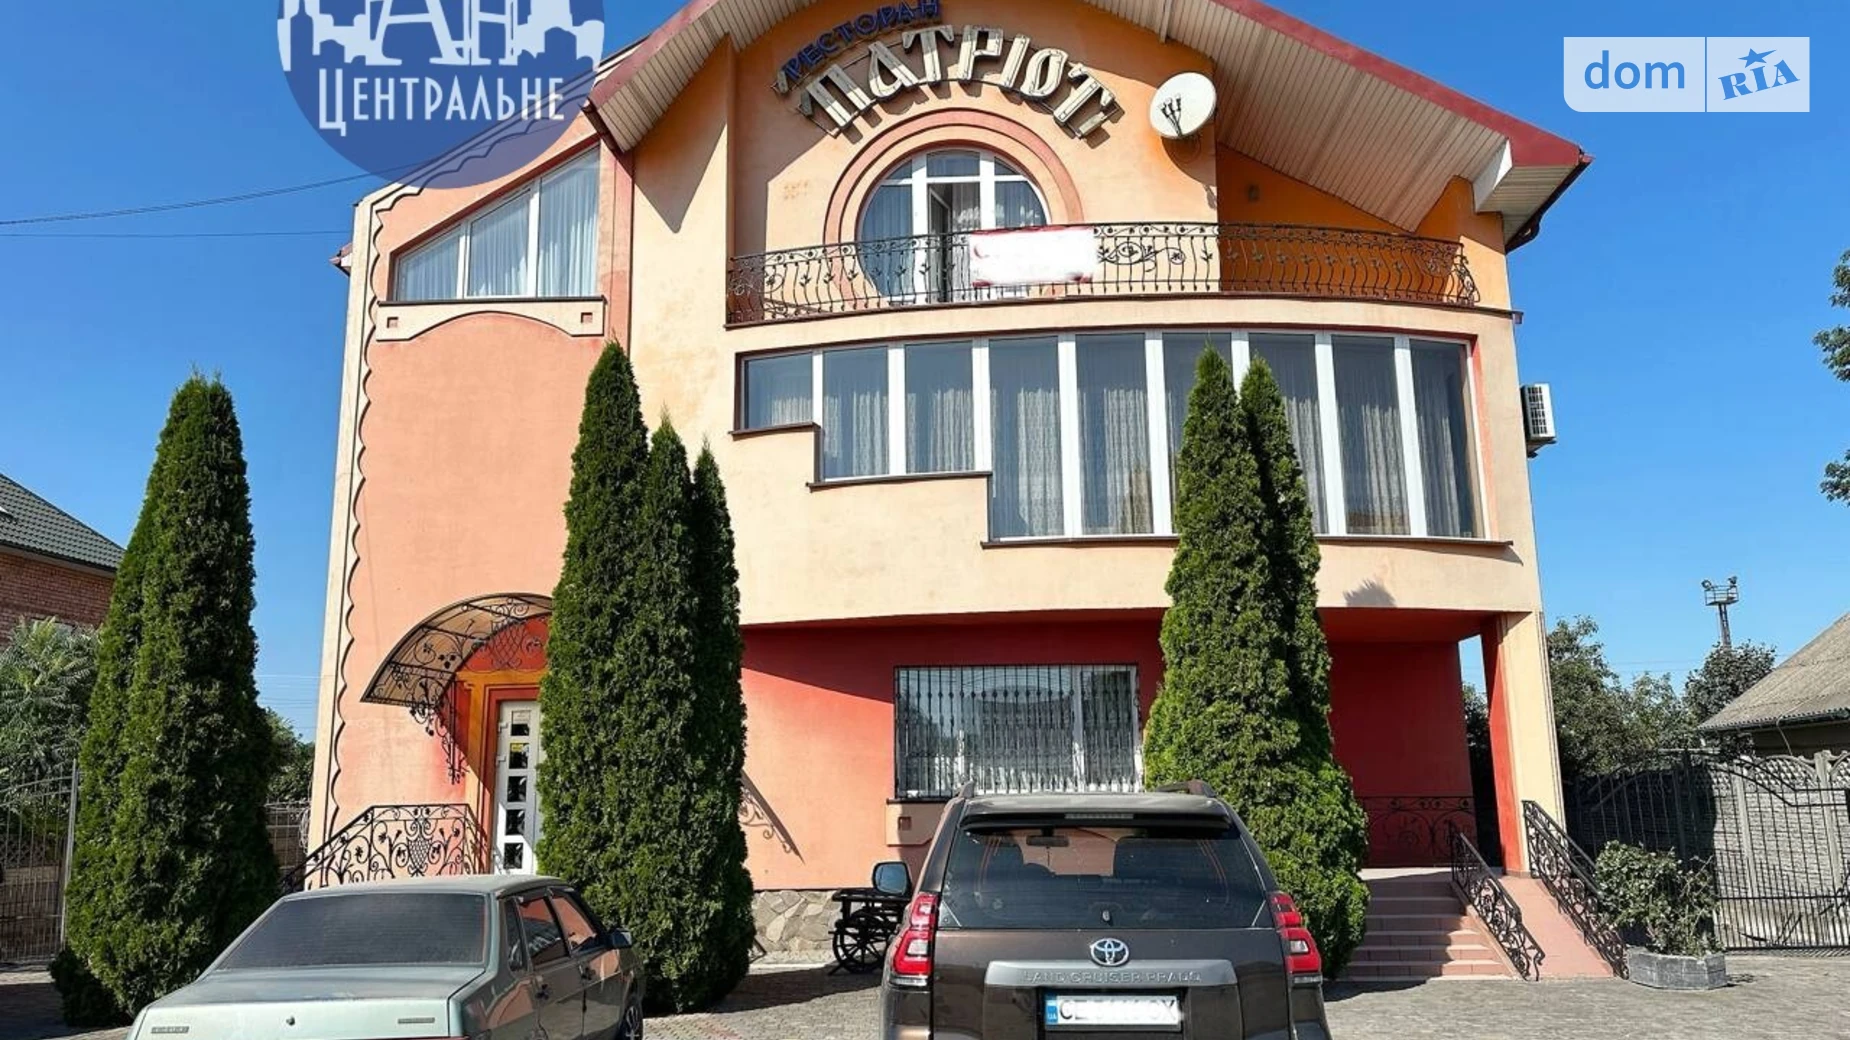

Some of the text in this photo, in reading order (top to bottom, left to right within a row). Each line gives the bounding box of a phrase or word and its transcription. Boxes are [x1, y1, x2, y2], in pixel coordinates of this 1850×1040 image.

[781, 0, 939, 81] РЕСТОРАН
[1024, 971, 1065, 983] LAND
[1069, 971, 1143, 983] CRUISER
